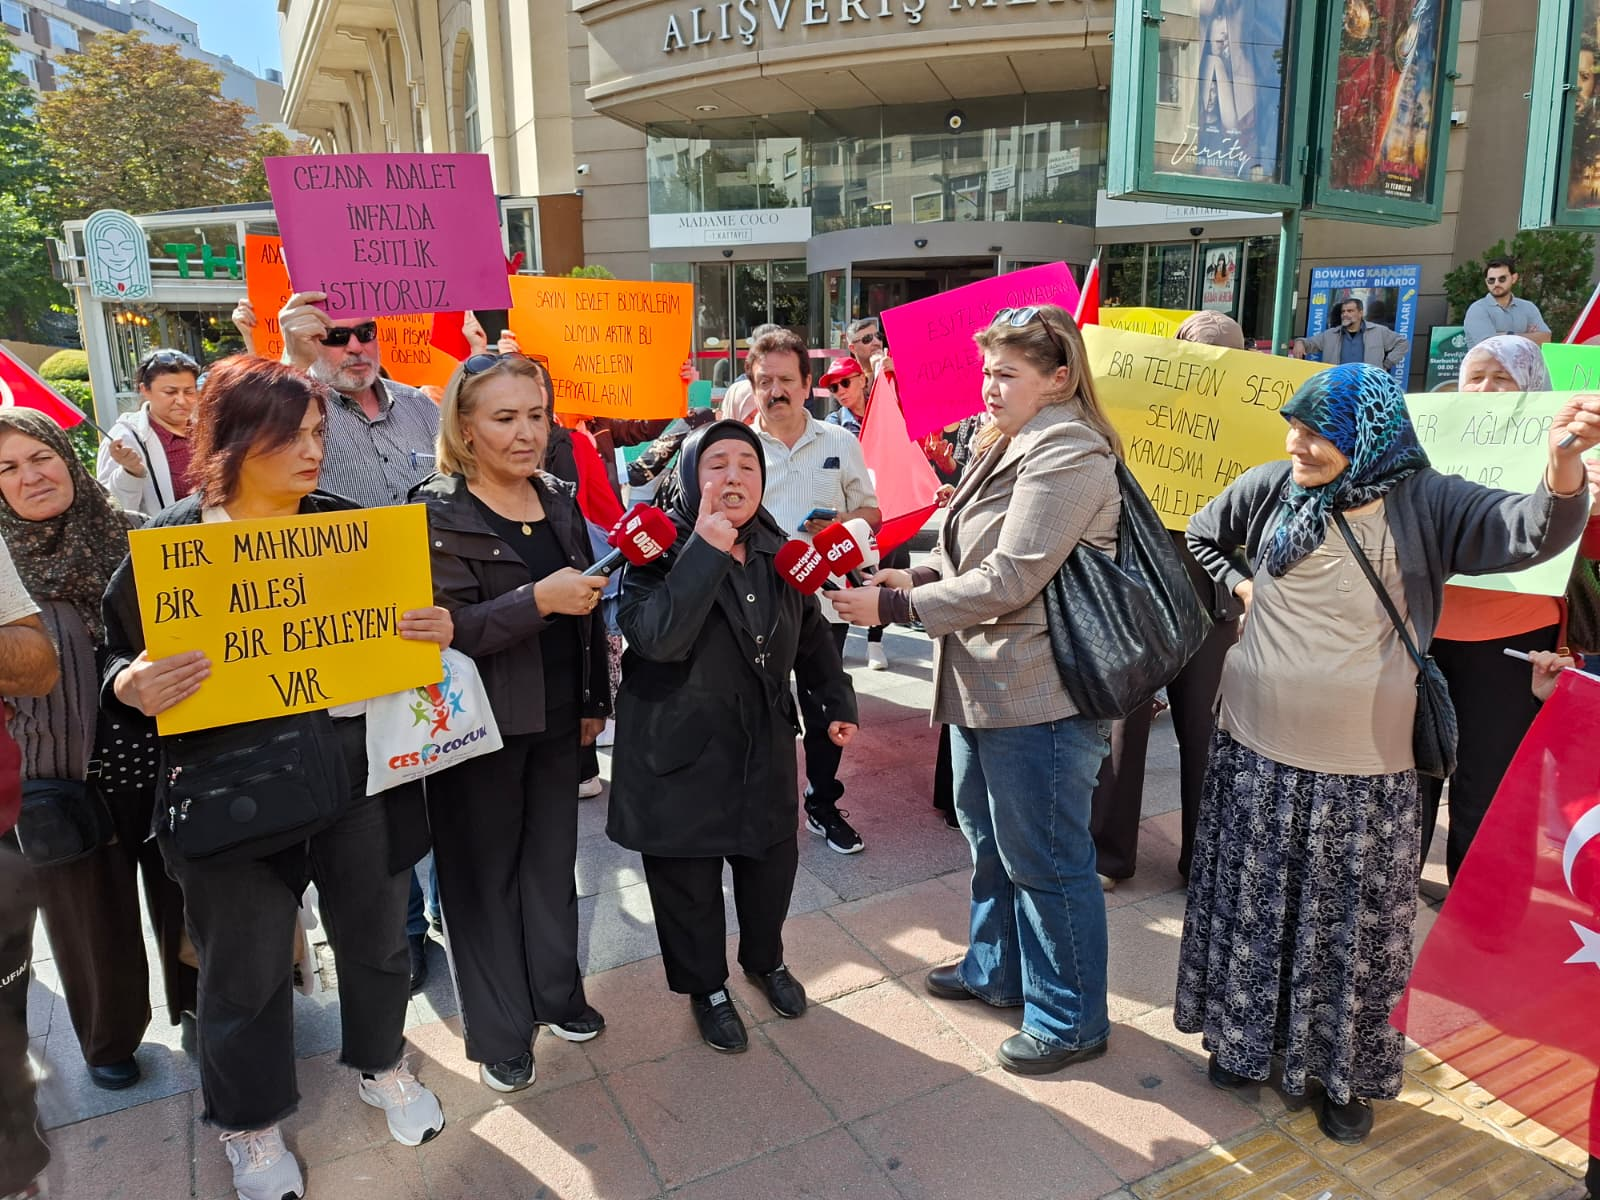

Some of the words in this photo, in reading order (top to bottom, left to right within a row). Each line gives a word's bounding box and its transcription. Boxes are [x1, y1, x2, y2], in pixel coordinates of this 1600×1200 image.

[1171, 132, 1251, 176] Verity
[294, 164, 372, 191] CEZADA
[386, 163, 456, 190] ADALET
[347, 203, 436, 231] İNFAZDA
[679, 214, 737, 228] MADAME
[740, 213, 779, 226] COCO
[164, 243, 242, 279] TH
[261, 244, 284, 264] ADA
[354, 237, 438, 269] EŞİTLİK
[1313, 279, 1329, 288] AIR
[1331, 279, 1368, 288] HOCKEY
[1374, 277, 1416, 287] BİLARDO
[1315, 269, 1365, 279] BOWLING
[1366, 267, 1417, 277] KARAOKE
[320, 278, 450, 312] İSTİYORUZ
[536, 290, 566, 309] SAYIN
[576, 292, 609, 311] DEVLET
[564, 324, 599, 343] DUYUN
[605, 325, 632, 344] ARTIK
[639, 325, 652, 345] BU
[917, 348, 980, 384] ADALE
[1144, 355, 1226, 398] TELEFON
[1241, 375, 1296, 411] SESİ
[1129, 436, 1203, 479] KAVUŞMA
[161, 539, 212, 570] HER
[233, 521, 369, 563] MAHKUMUN
[633, 531, 663, 559] Olay
[827, 538, 855, 561] eha
[154, 586, 202, 624] BİR
[229, 572, 307, 614] AİLESİ
[224, 626, 271, 663] BİR
[283, 602, 399, 653] BEKLEYENİ
[268, 667, 332, 707] VAR
